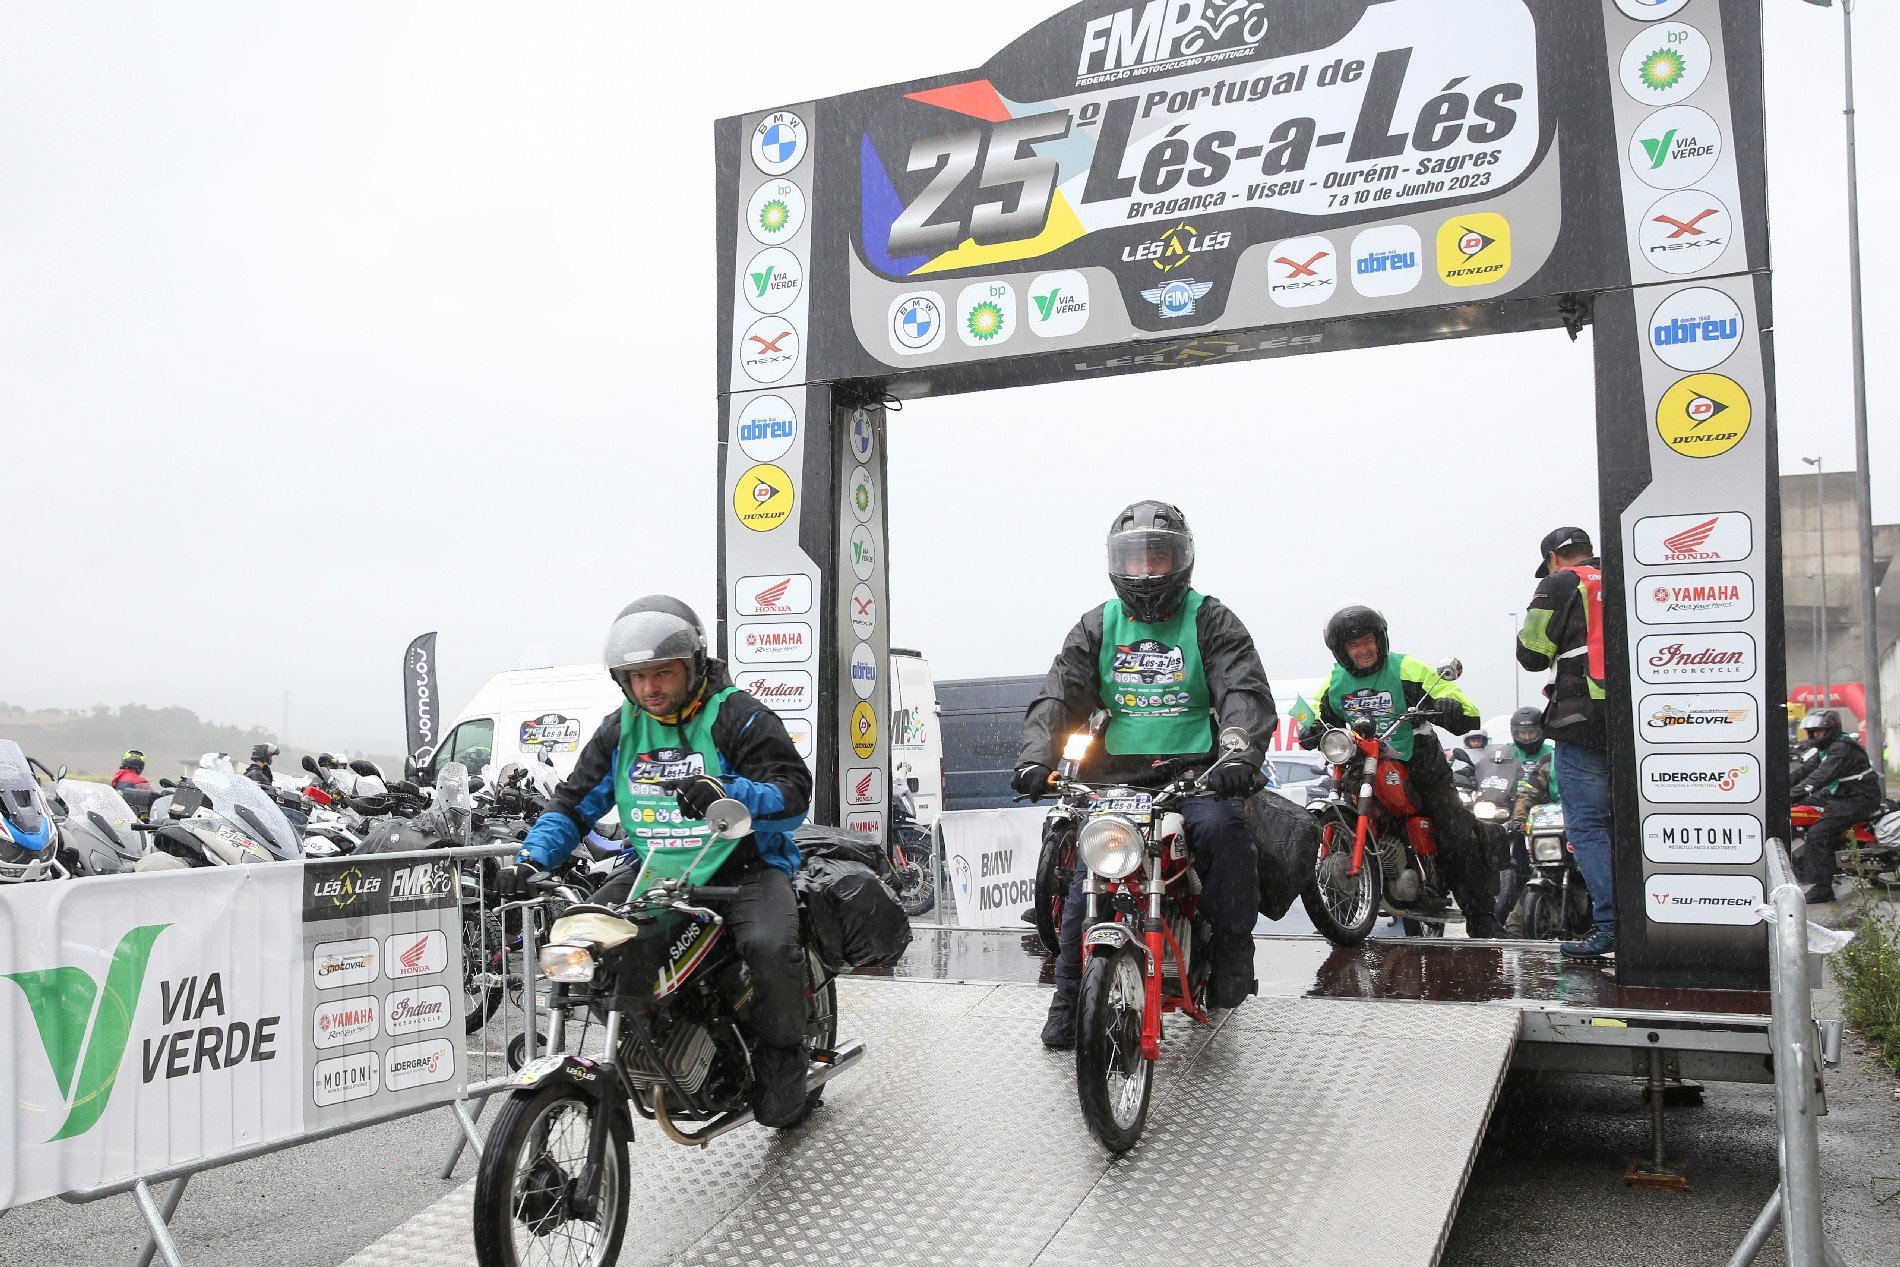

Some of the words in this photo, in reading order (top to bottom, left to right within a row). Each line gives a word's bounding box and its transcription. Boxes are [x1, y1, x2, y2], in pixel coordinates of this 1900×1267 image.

[1078, 0, 1205, 75] FMP
[1667, 30, 1689, 44] bp
[1075, 71, 1130, 87] FEDERAÇÃO
[1132, 57, 1202, 77] MOTOCICLISMO
[1204, 47, 1255, 63] PORTUGAL
[1142, 66, 1308, 119] Portugal
[1317, 58, 1365, 88] de
[758, 113, 800, 135] BMW
[1080, 46, 1524, 204] Lés-a-Lés
[1675, 137, 1697, 149] VIA
[1671, 145, 1714, 160] VERDE
[777, 185, 792, 197] bp
[1127, 191, 1226, 219] Bragança
[1246, 181, 1304, 202] Viseu
[1323, 164, 1399, 190] Ourém
[1415, 149, 1502, 176] Sagres
[1328, 194, 1337, 208] 7
[1338, 193, 1349, 205] a
[1353, 190, 1369, 204] 10
[1373, 186, 1392, 201] de
[1396, 179, 1444, 198] Junho
[1448, 172, 1491, 190] 2023
[1121, 239, 1164, 262] LÉS
[1187, 231, 1231, 252] LÉS
[1356, 251, 1415, 275] abreu
[1446, 264, 1504, 278] DUNLOP
[770, 279, 798, 290] VERDE
[773, 273, 788, 282] VIA
[990, 285, 1006, 298] bp
[1165, 289, 1189, 308] FIM
[900, 300, 934, 316] BMW
[1056, 302, 1086, 314] VERDE
[1059, 295, 1074, 305] VIA
[1654, 318, 1737, 346] abreu
[741, 419, 793, 441] abreu
[1671, 432, 1737, 444] DUNLOP
[743, 511, 785, 521] DUNLOP
[1664, 552, 1722, 561] HONDA
[1672, 586, 1740, 601] YAMAHA
[755, 605, 792, 613] HONDA
[759, 633, 802, 645] YAMAHA
[1649, 643, 1742, 667] Indian
[1653, 667, 1740, 675] MOTORCYCLE
[748, 678, 804, 697] Indian
[1651, 772, 1725, 782] LIDERGRAF
[1663, 828, 1742, 844] MOTONI
[982, 850, 1013, 878] BMW
[314, 878, 341, 896] LÉS
[355, 876, 381, 893] LÉS
[391, 863, 432, 896] FMP
[1671, 897, 1752, 906] SW-MOTECH
[670, 922, 700, 960] SACHS
[400, 965, 430, 975] HONDA
[160, 972, 225, 1026] VIA
[391, 998, 441, 1021] Indian
[332, 1008, 373, 1028] YAMAHA
[393, 1016, 440, 1027] MOTORCYCLE
[142, 1015, 280, 1084] VERDE
[391, 1057, 431, 1072] LIDERGRAF
[324, 1065, 371, 1089] MOTONI
